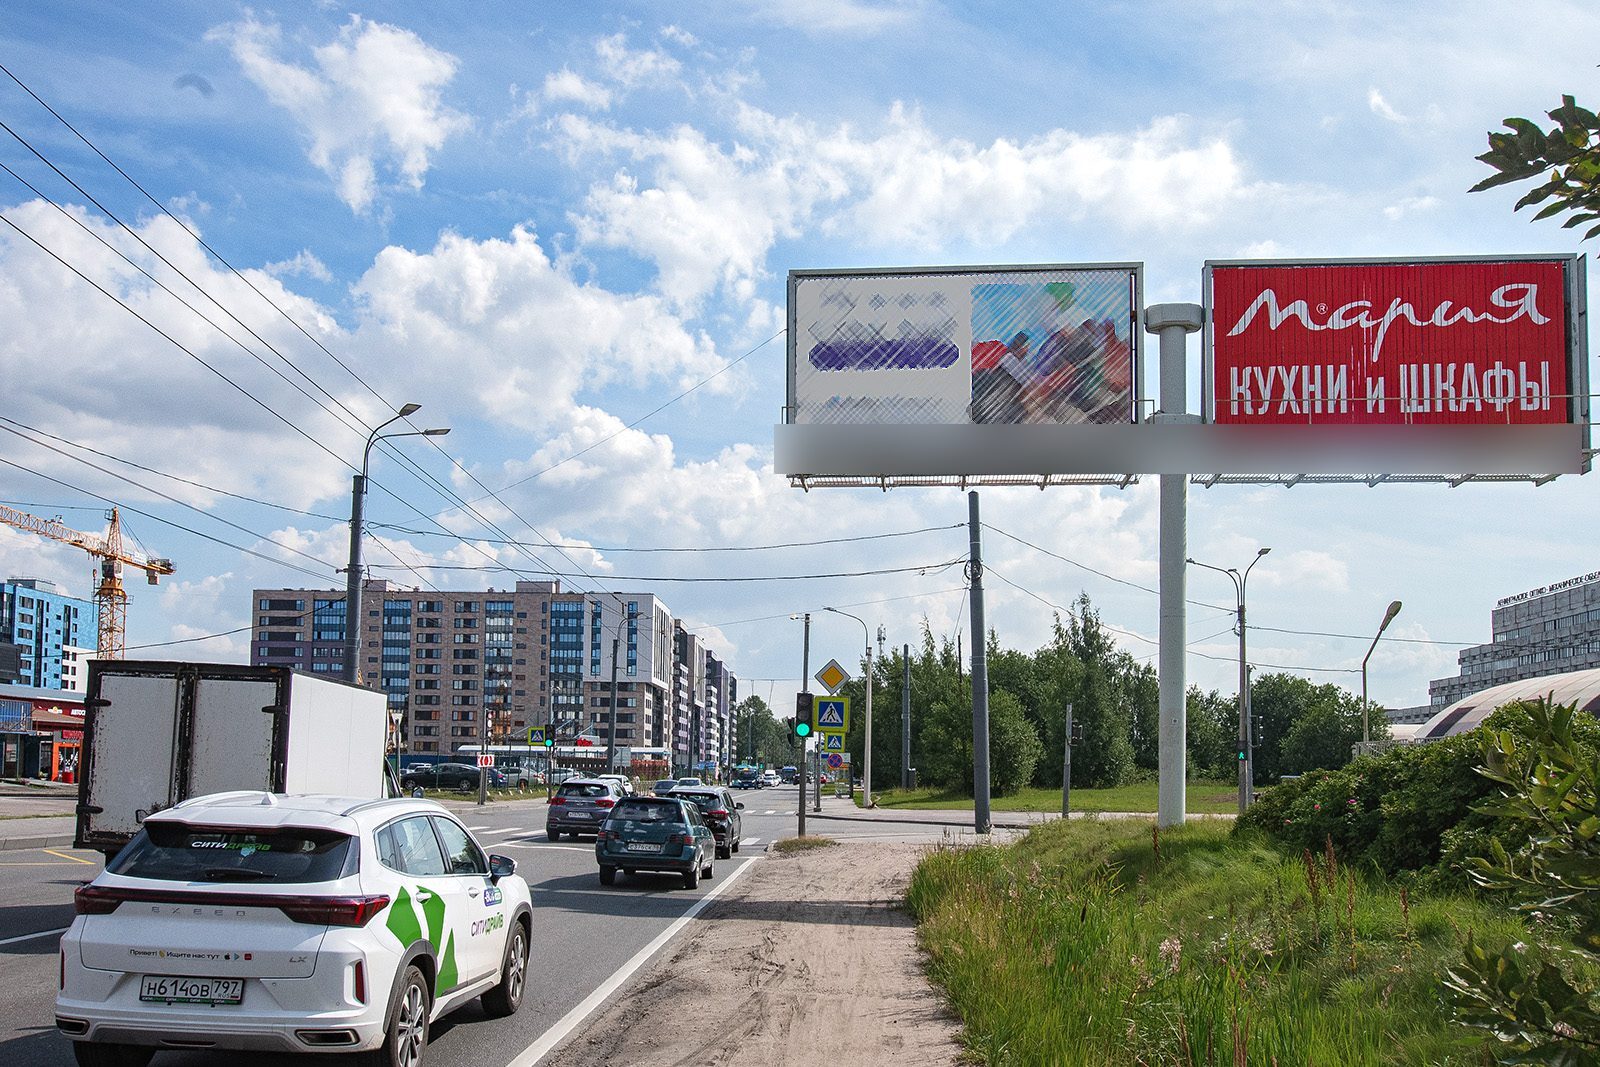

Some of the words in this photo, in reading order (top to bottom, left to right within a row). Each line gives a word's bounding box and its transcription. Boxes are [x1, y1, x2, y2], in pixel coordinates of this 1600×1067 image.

[1226, 283, 1551, 363] Мария
[1230, 363, 1348, 416] КУХНИ
[1399, 360, 1550, 413] ШКАФЫ
[129, 949, 158, 957] Привет!
[166, 951, 192, 959] Ищите
[206, 953, 220, 961] тут
